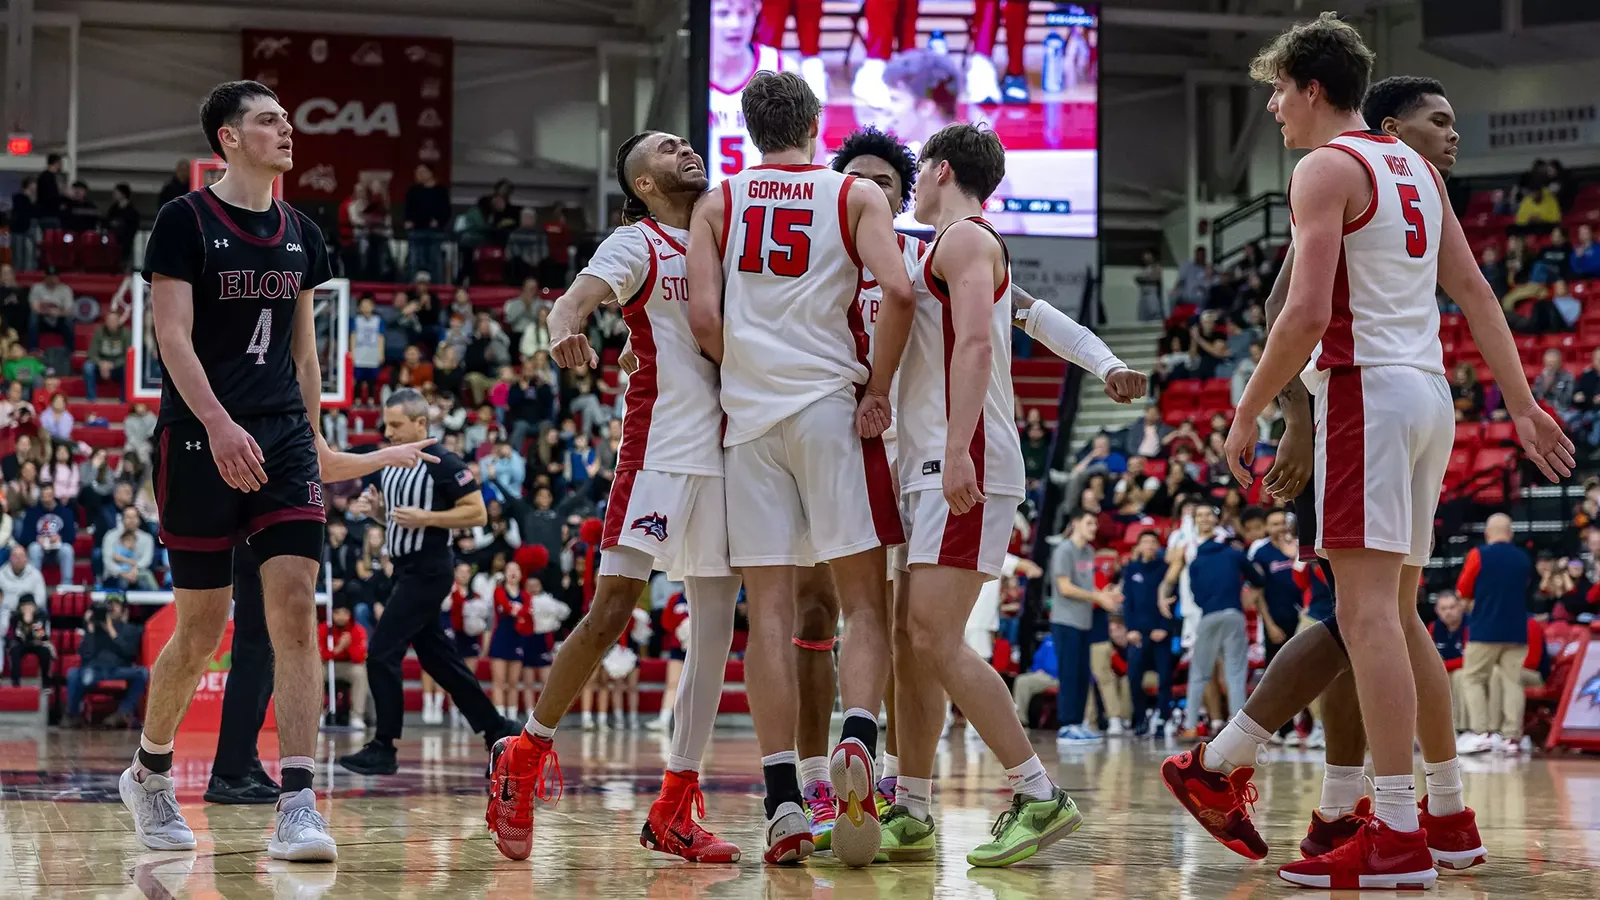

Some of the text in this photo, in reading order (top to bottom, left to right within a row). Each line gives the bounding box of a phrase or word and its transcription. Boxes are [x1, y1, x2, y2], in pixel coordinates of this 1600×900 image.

[294, 98, 400, 136] CAA
[720, 136, 743, 175] 5
[1382, 154, 1413, 177] WIGHT
[748, 180, 814, 200] GORMAN
[1396, 183, 1427, 258] 5
[286, 243, 302, 252] CAA
[738, 205, 813, 278] 15
[218, 270, 302, 299] ELON
[246, 308, 272, 365] 4
[306, 481, 324, 507] E
